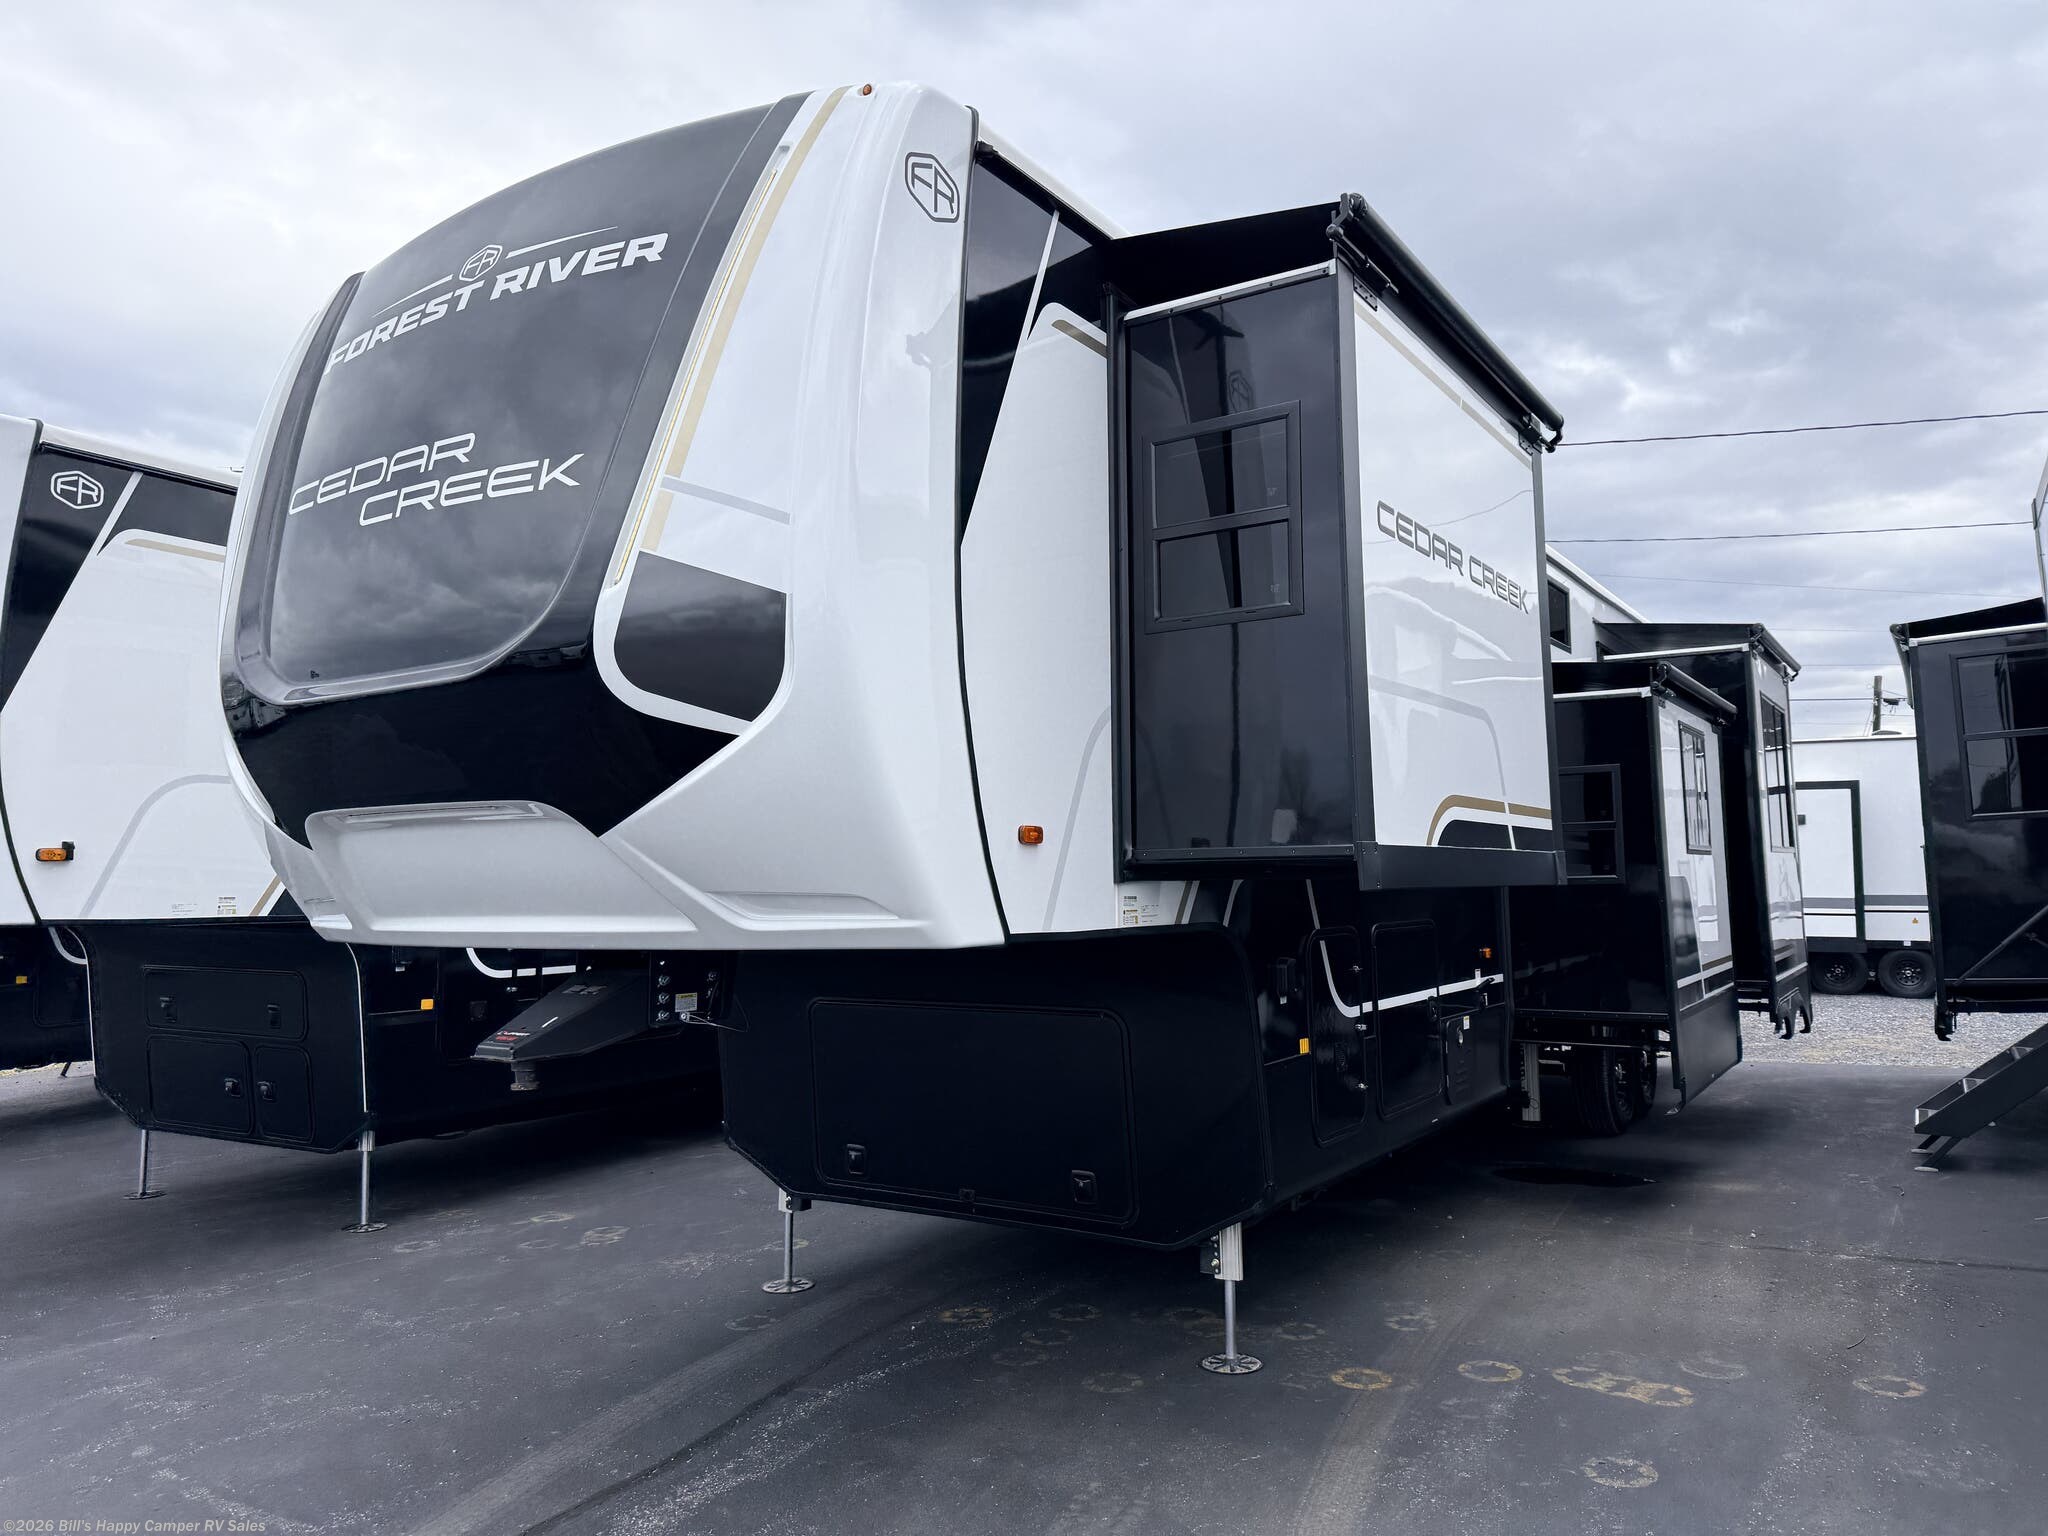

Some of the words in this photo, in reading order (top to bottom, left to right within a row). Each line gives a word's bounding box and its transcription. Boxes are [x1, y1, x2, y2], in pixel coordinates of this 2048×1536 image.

[323, 280, 486, 376] FOREST
[489, 232, 669, 301] RIVER
[288, 432, 476, 515] CEDAR
[358, 453, 585, 527] CREEK
[1376, 500, 1464, 577] CEDAR
[1469, 555, 1529, 615] CREEK
